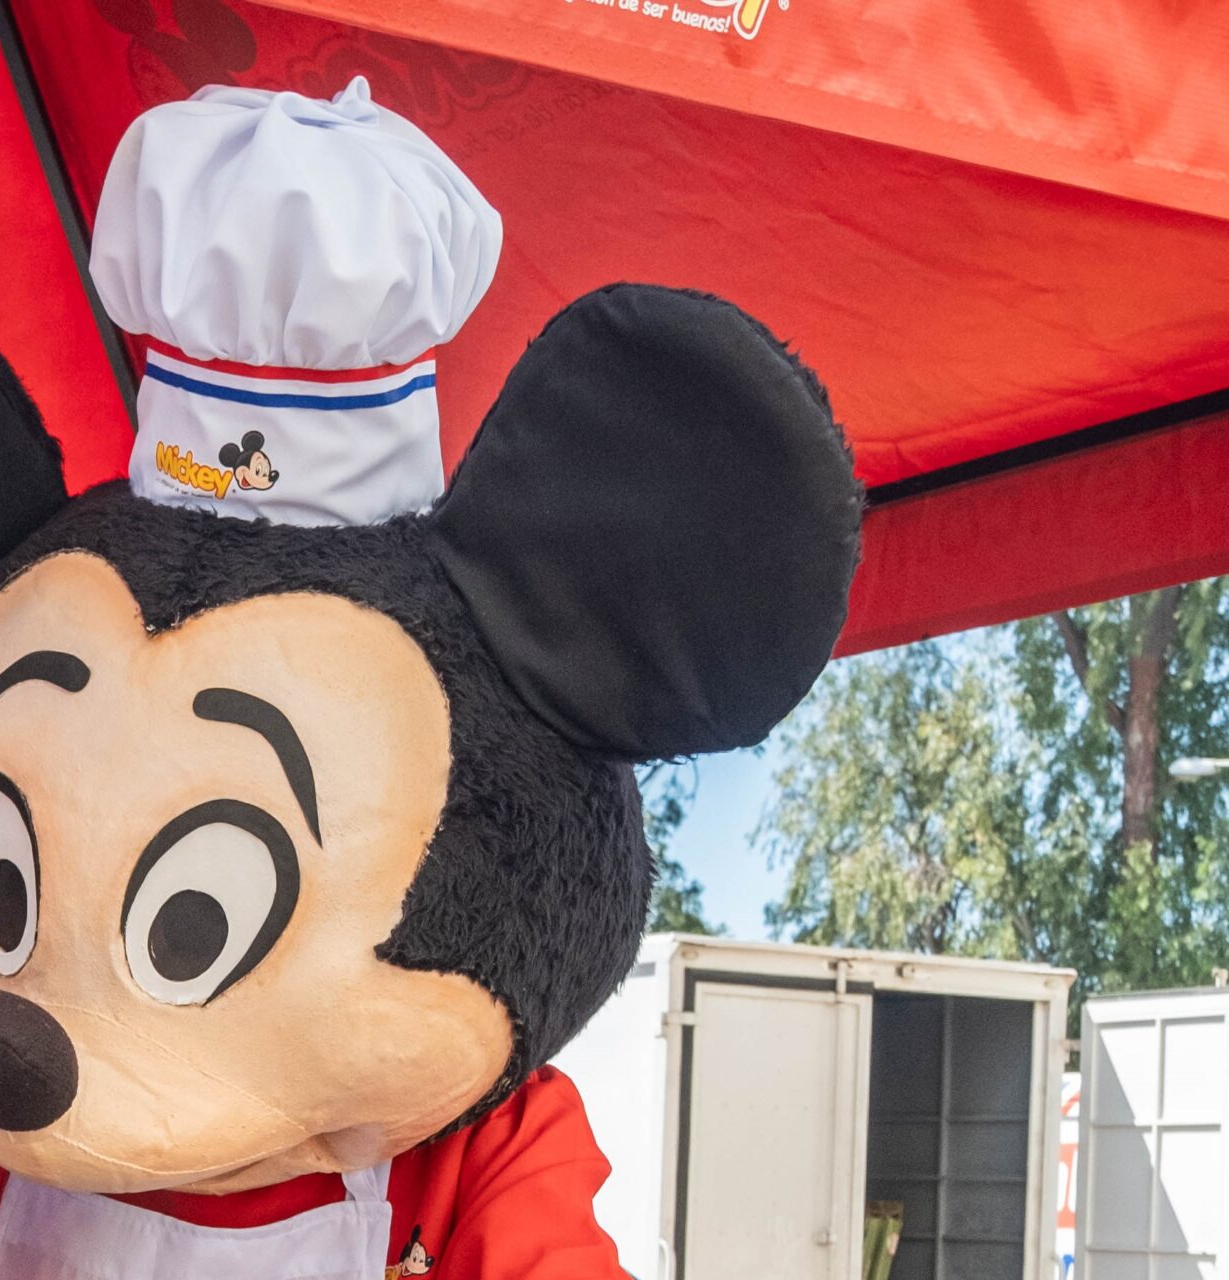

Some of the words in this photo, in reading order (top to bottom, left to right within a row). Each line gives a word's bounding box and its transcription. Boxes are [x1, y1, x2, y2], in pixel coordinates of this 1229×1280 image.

[642, 4, 669, 19] ser
[671, 8, 731, 33] buenos!
[156, 441, 233, 500] Mickey
